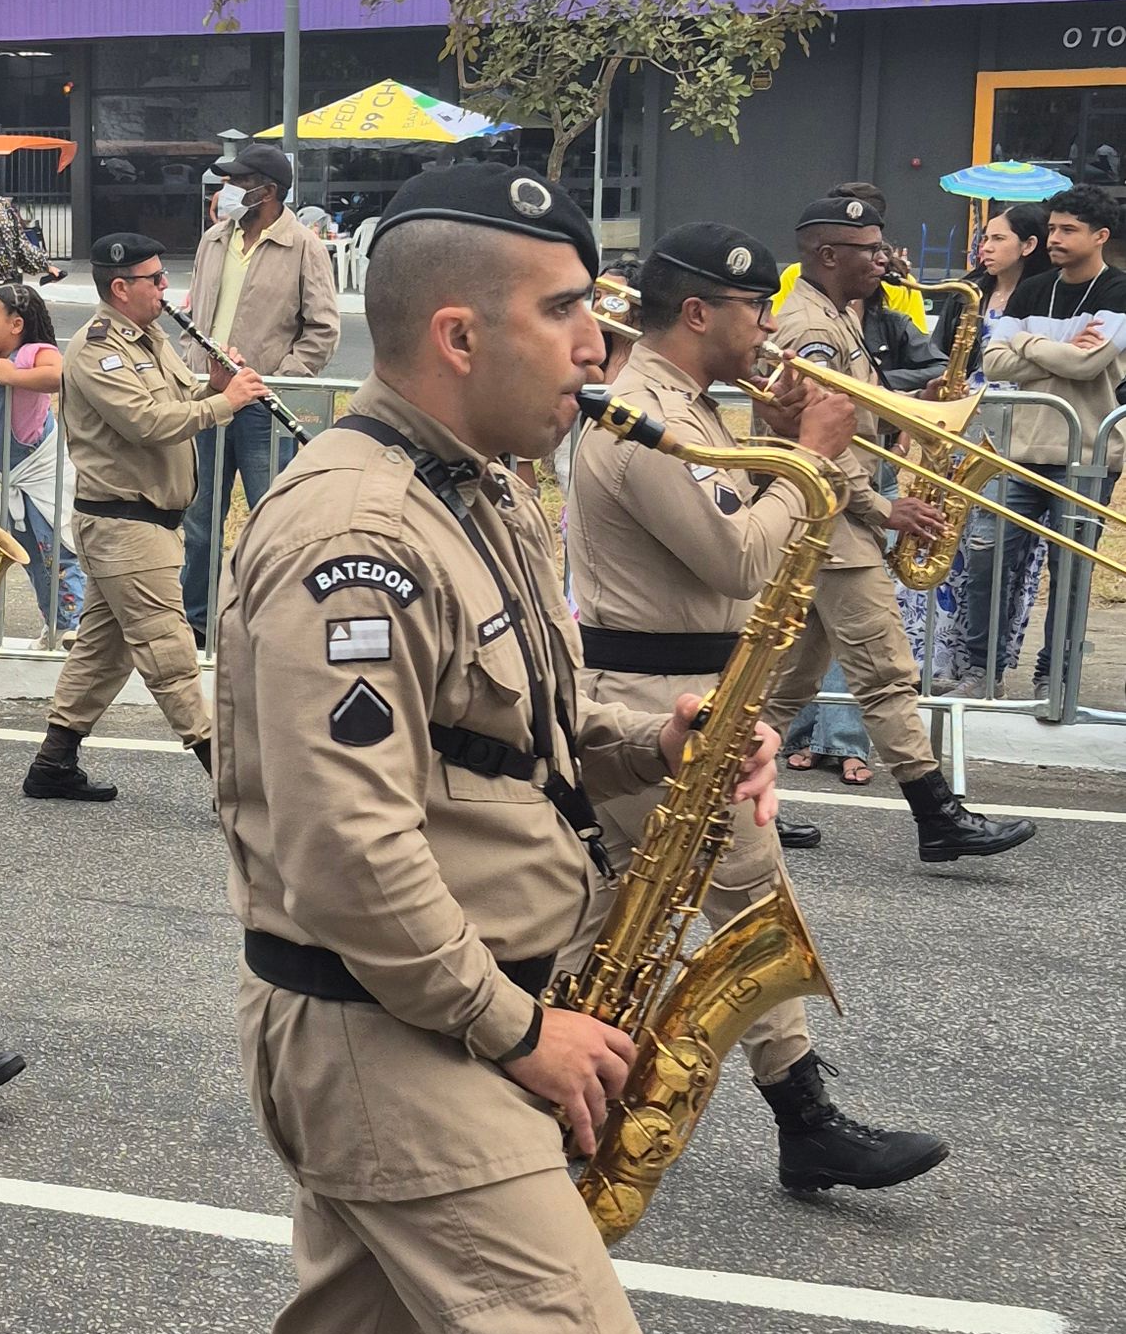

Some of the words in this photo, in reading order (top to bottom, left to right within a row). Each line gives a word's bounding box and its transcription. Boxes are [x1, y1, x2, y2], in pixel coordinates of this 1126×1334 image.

[1063, 27, 1082, 48] O
[360, 112, 384, 131] 99
[373, 79, 399, 108] CH
[315, 561, 414, 599] BATEDOR
